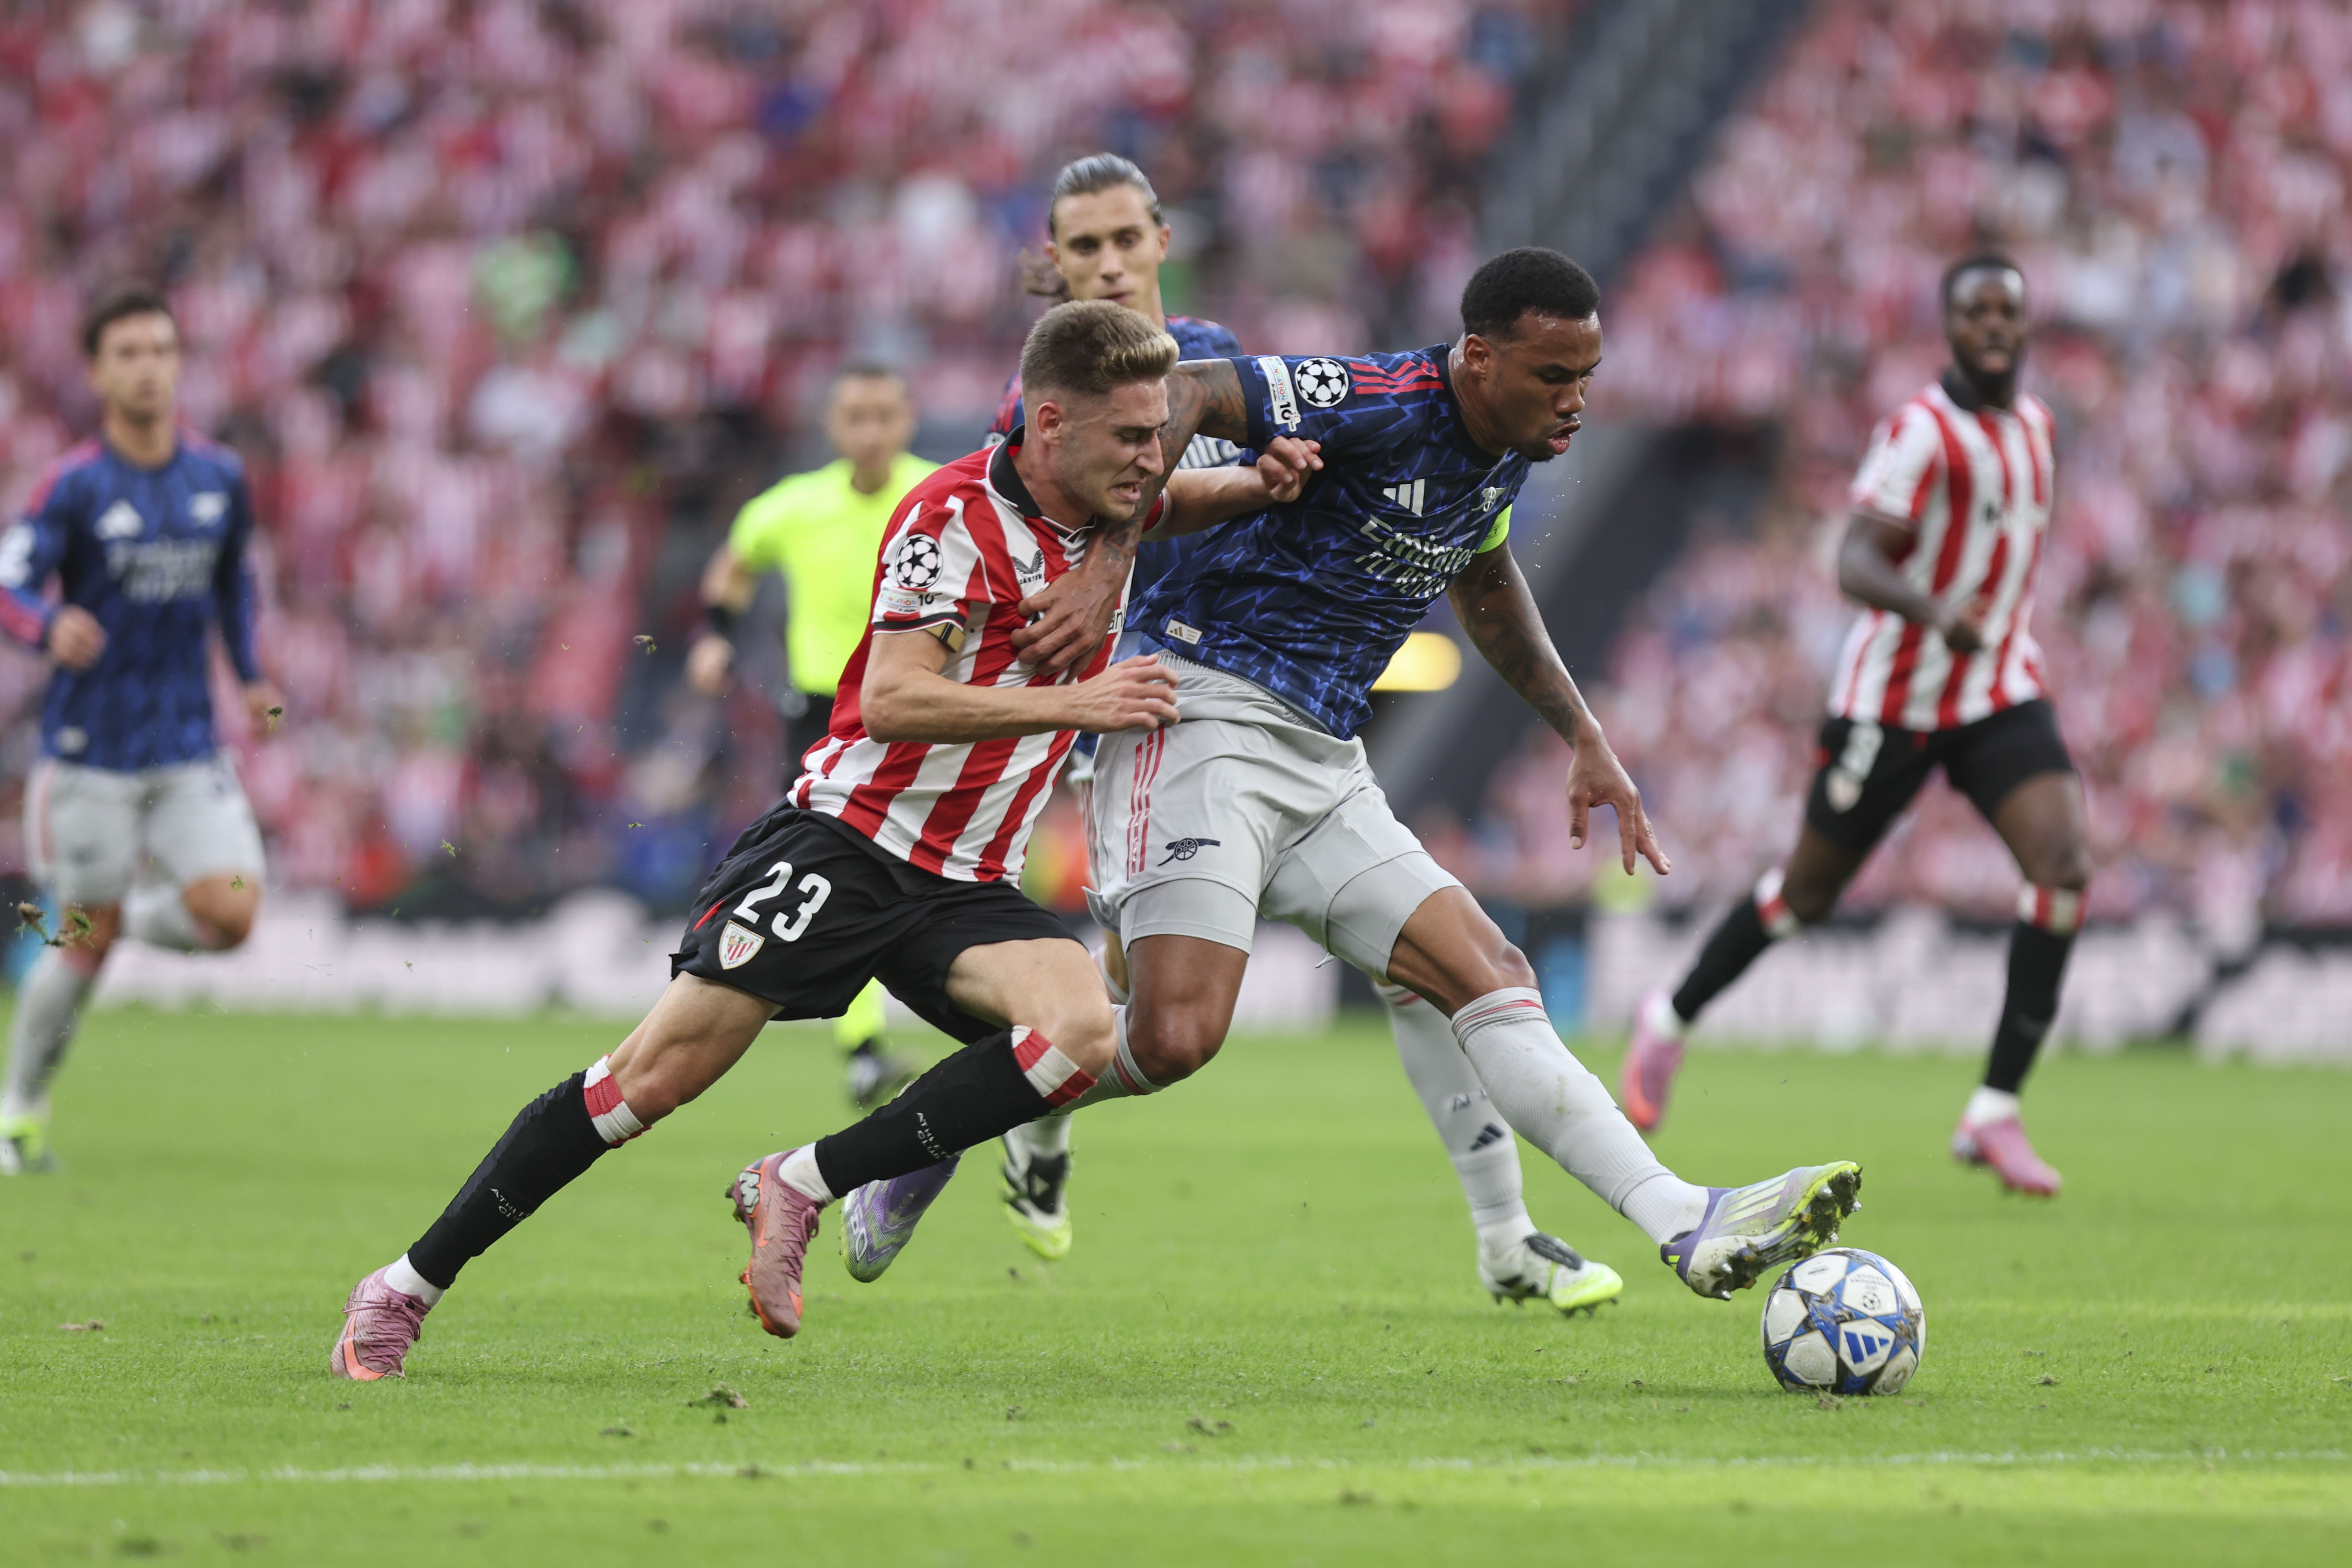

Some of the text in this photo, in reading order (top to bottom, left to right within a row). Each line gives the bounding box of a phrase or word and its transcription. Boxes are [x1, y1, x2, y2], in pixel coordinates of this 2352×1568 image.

[1267, 358, 1287, 400] FOUNDATION
[1280, 401, 1292, 420] 10
[1360, 514, 1477, 574] Emirates
[1354, 550, 1447, 600] FLY BETTER
[918, 593, 935, 606] 10
[733, 861, 832, 942] 23
